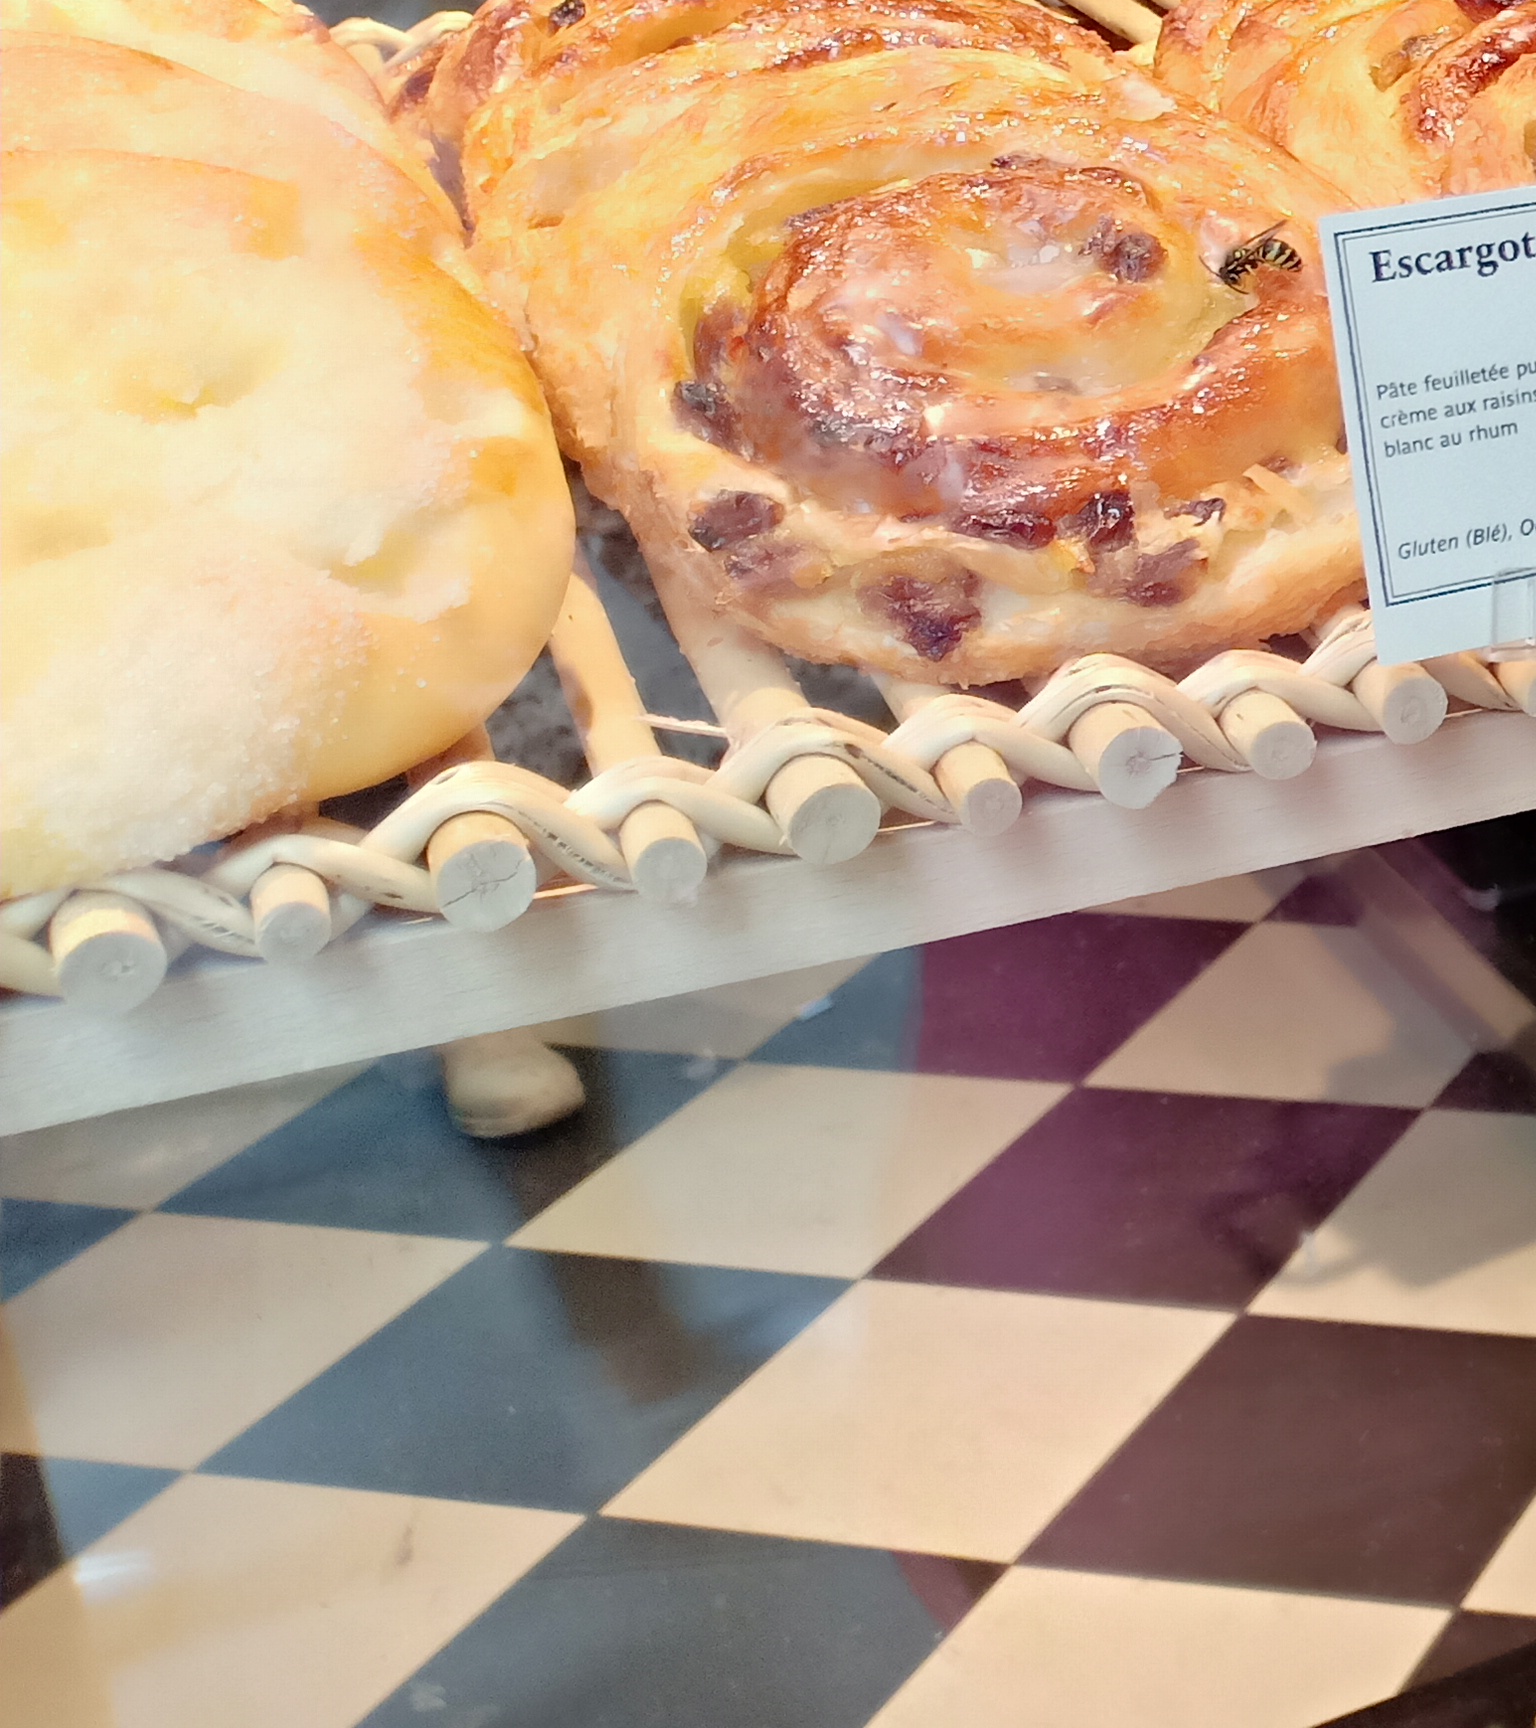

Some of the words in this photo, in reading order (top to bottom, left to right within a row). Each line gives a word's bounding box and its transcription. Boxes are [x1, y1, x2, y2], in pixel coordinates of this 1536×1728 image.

[1368, 232, 1536, 283] Escargot
[1376, 381, 1417, 401] Pâte
[1423, 364, 1509, 392] feuilletée
[1380, 407, 1438, 429] crème
[1443, 400, 1477, 418] aux
[1383, 436, 1434, 458] blanc
[1439, 432, 1462, 448] au
[1468, 422, 1518, 442] rhum
[1397, 536, 1459, 560] Gluten
[1465, 523, 1512, 549] (Blé),
